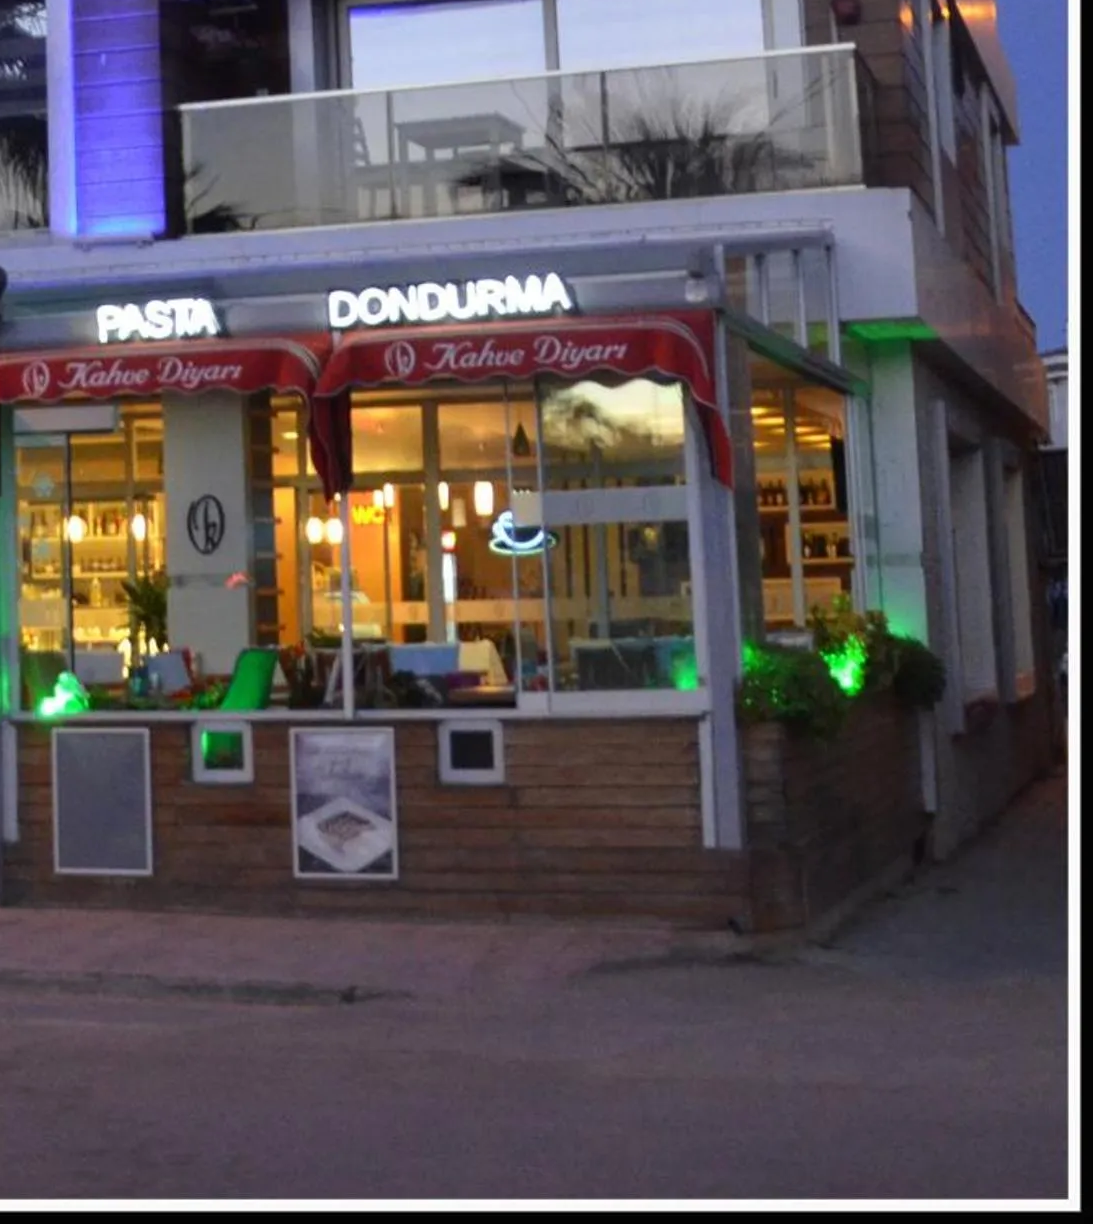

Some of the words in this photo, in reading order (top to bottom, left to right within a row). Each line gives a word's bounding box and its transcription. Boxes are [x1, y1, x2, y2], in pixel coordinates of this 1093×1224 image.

[328, 272, 571, 328] DONDURMA
[96, 298, 218, 343] PASTA
[424, 338, 525, 369] Kahve
[532, 335, 628, 370] Diyarı
[59, 359, 150, 388] Kahve
[157, 356, 242, 389] Diyarı
[351, 504, 385, 525] WC
